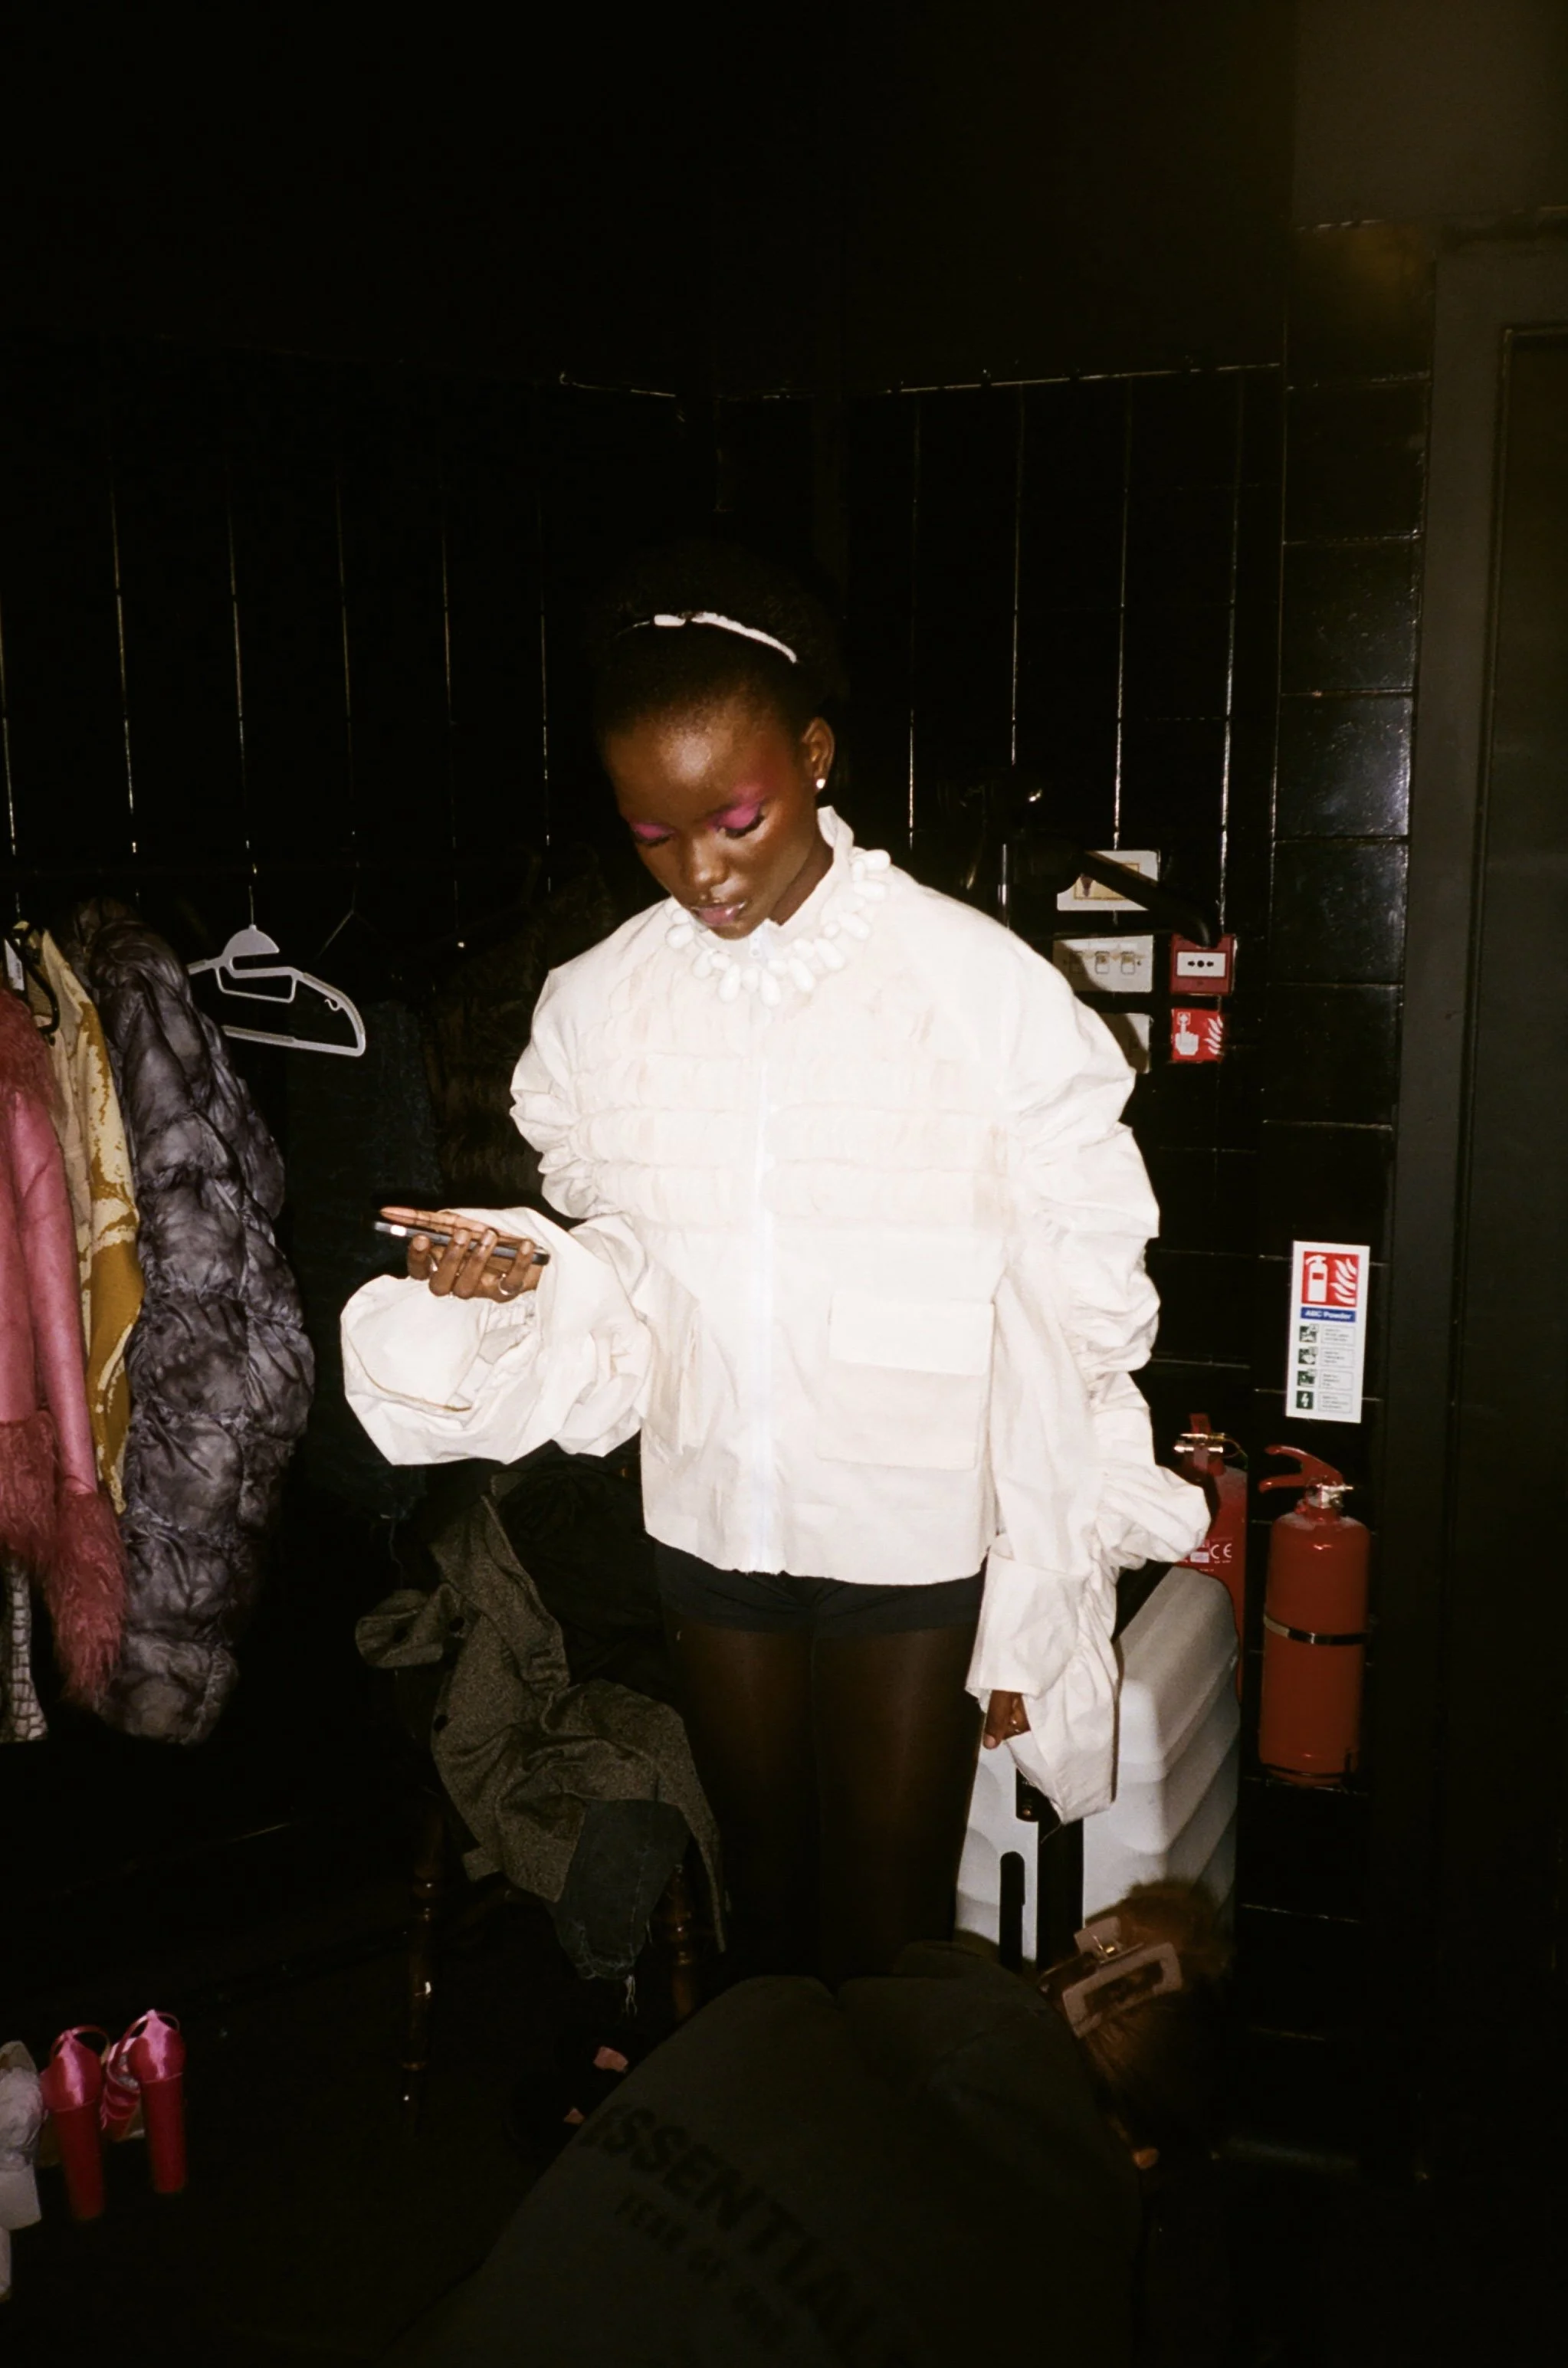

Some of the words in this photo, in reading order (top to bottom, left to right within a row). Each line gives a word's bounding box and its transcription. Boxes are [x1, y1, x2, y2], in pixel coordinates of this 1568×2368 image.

[1305, 1309, 1322, 1318] ABC
[1210, 1543, 1232, 1560] CE
[615, 2192, 688, 2252] FEAR
